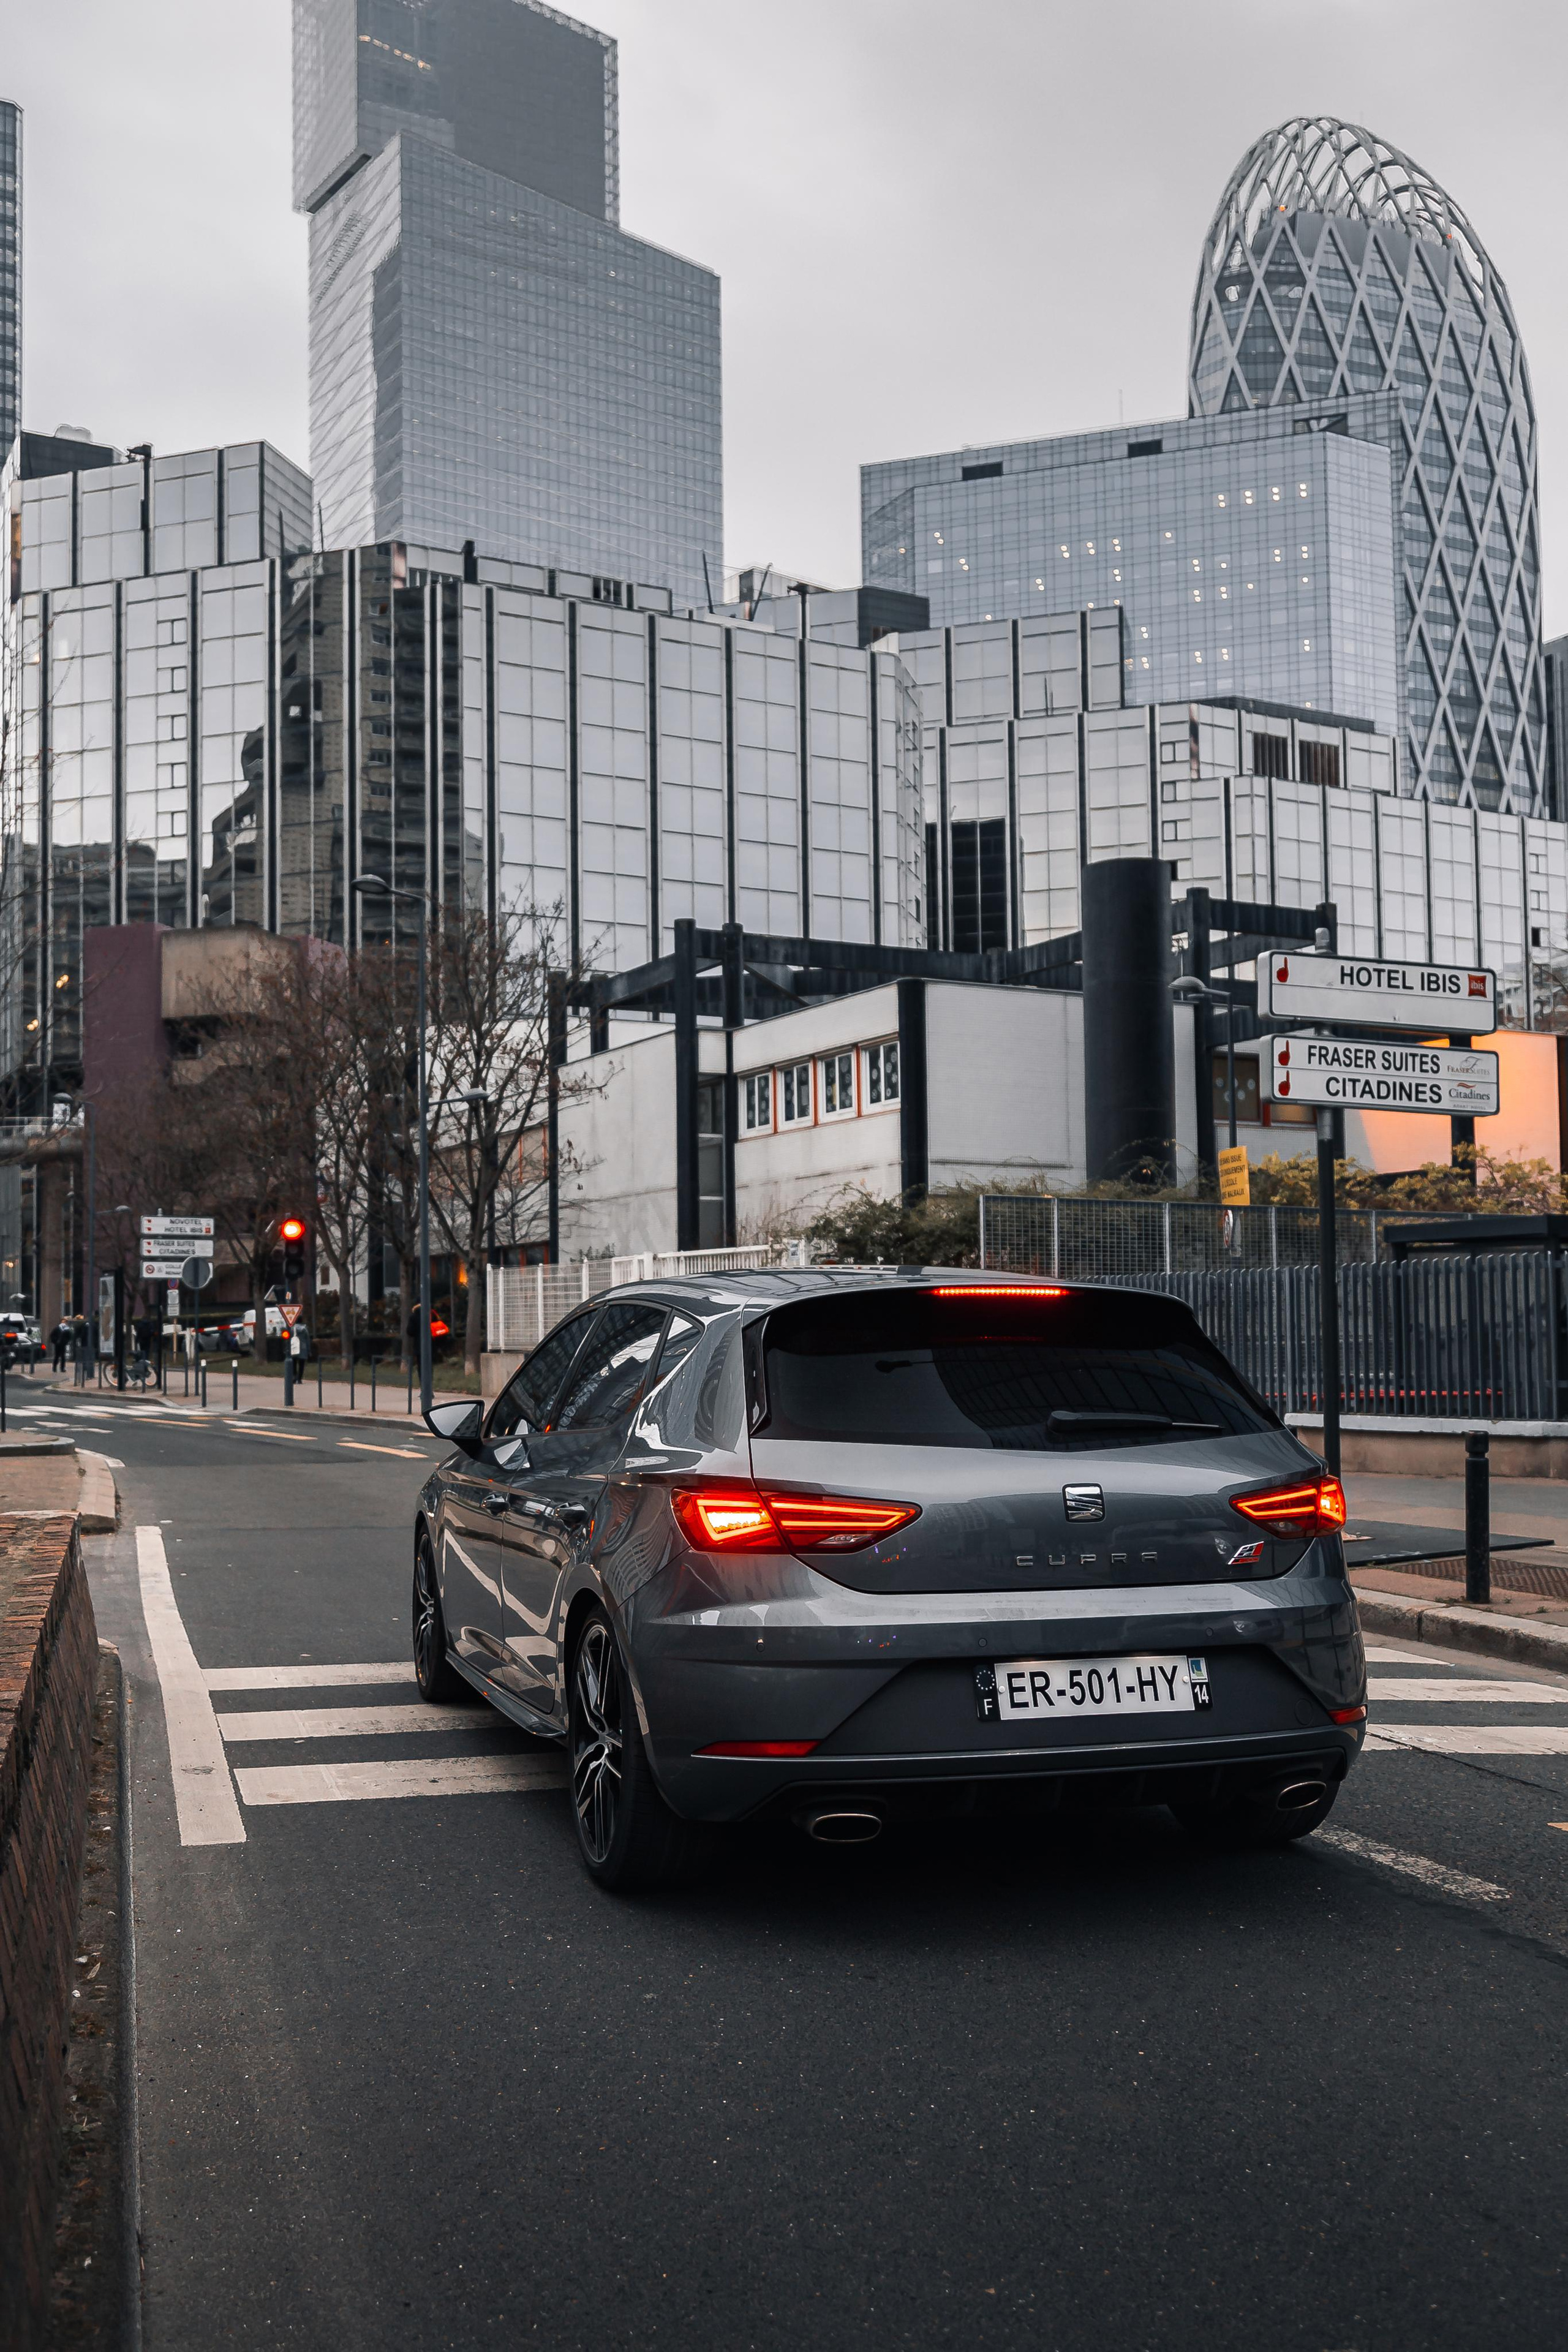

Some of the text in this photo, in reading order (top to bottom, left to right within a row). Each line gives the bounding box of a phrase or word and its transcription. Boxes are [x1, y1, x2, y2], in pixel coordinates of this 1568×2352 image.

[1340, 965, 1461, 994] HOTEL IBIS
[1471, 980, 1484, 990] ibis
[1308, 1045, 1441, 1074] FRASER SUITES
[1325, 1076, 1442, 1104] CITADINES
[1449, 1088, 1491, 1100] Citadines
[1016, 1551, 1158, 1566] CUPRA
[1006, 1664, 1179, 1709] ER-501-HY
[1194, 1684, 1209, 1703] 14
[984, 1698, 993, 1715] F
